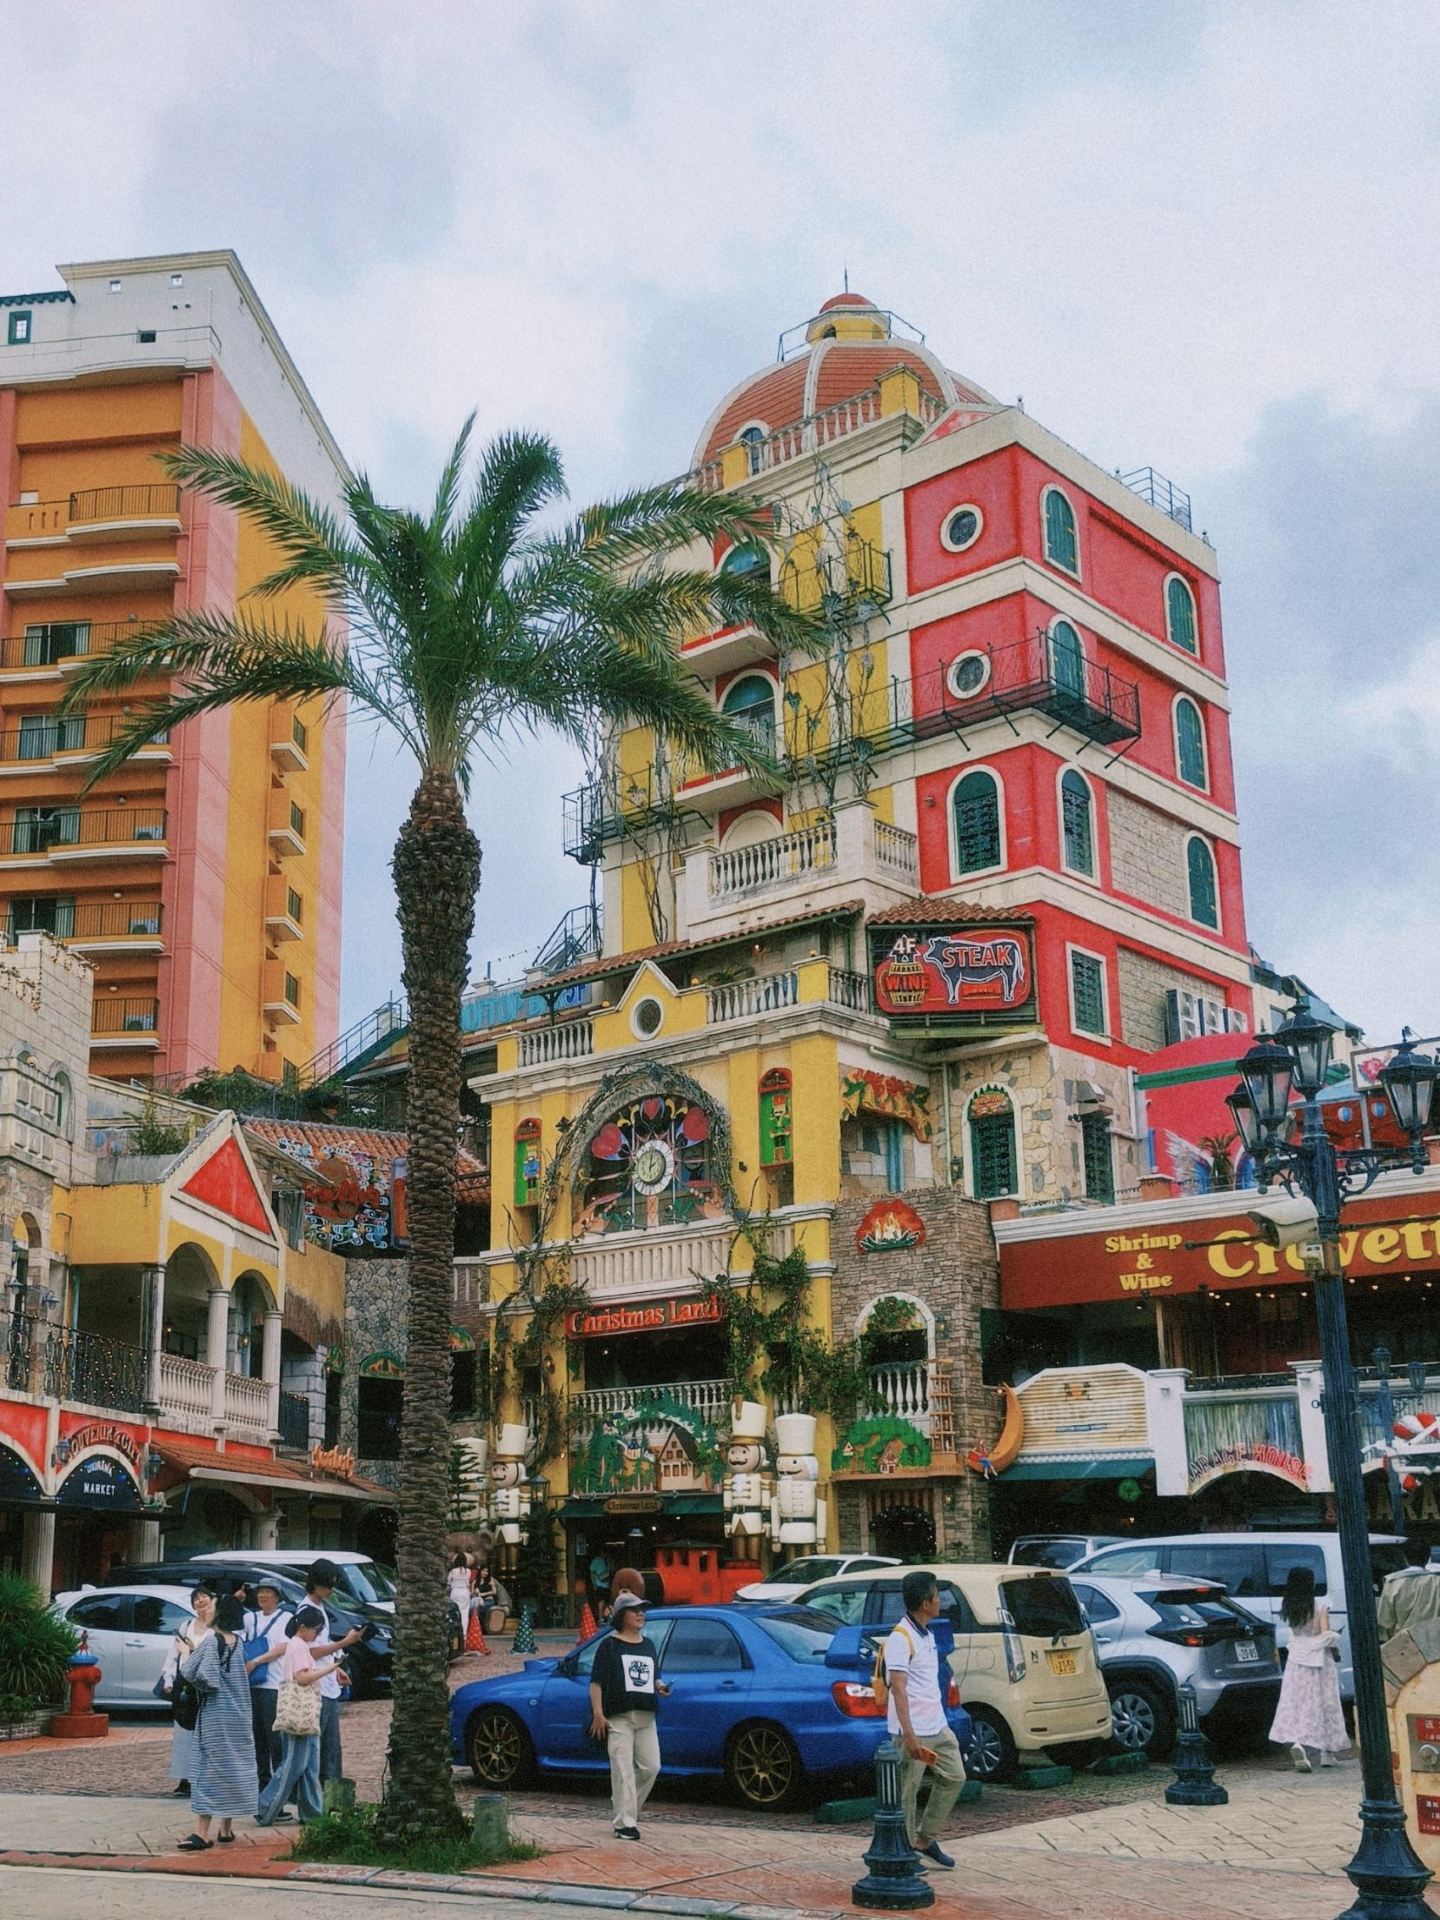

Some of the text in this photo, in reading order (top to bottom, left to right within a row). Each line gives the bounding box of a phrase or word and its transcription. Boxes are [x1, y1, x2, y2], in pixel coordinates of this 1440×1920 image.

[942, 945, 1013, 968] STEAK
[885, 974, 930, 991] WINE
[1105, 1232, 1183, 1253] Shrimp
[1136, 1252, 1154, 1270] &
[1119, 1272, 1173, 1290] Wine
[669, 1295, 719, 1322] Land
[83, 1482, 115, 1496] MARKET
